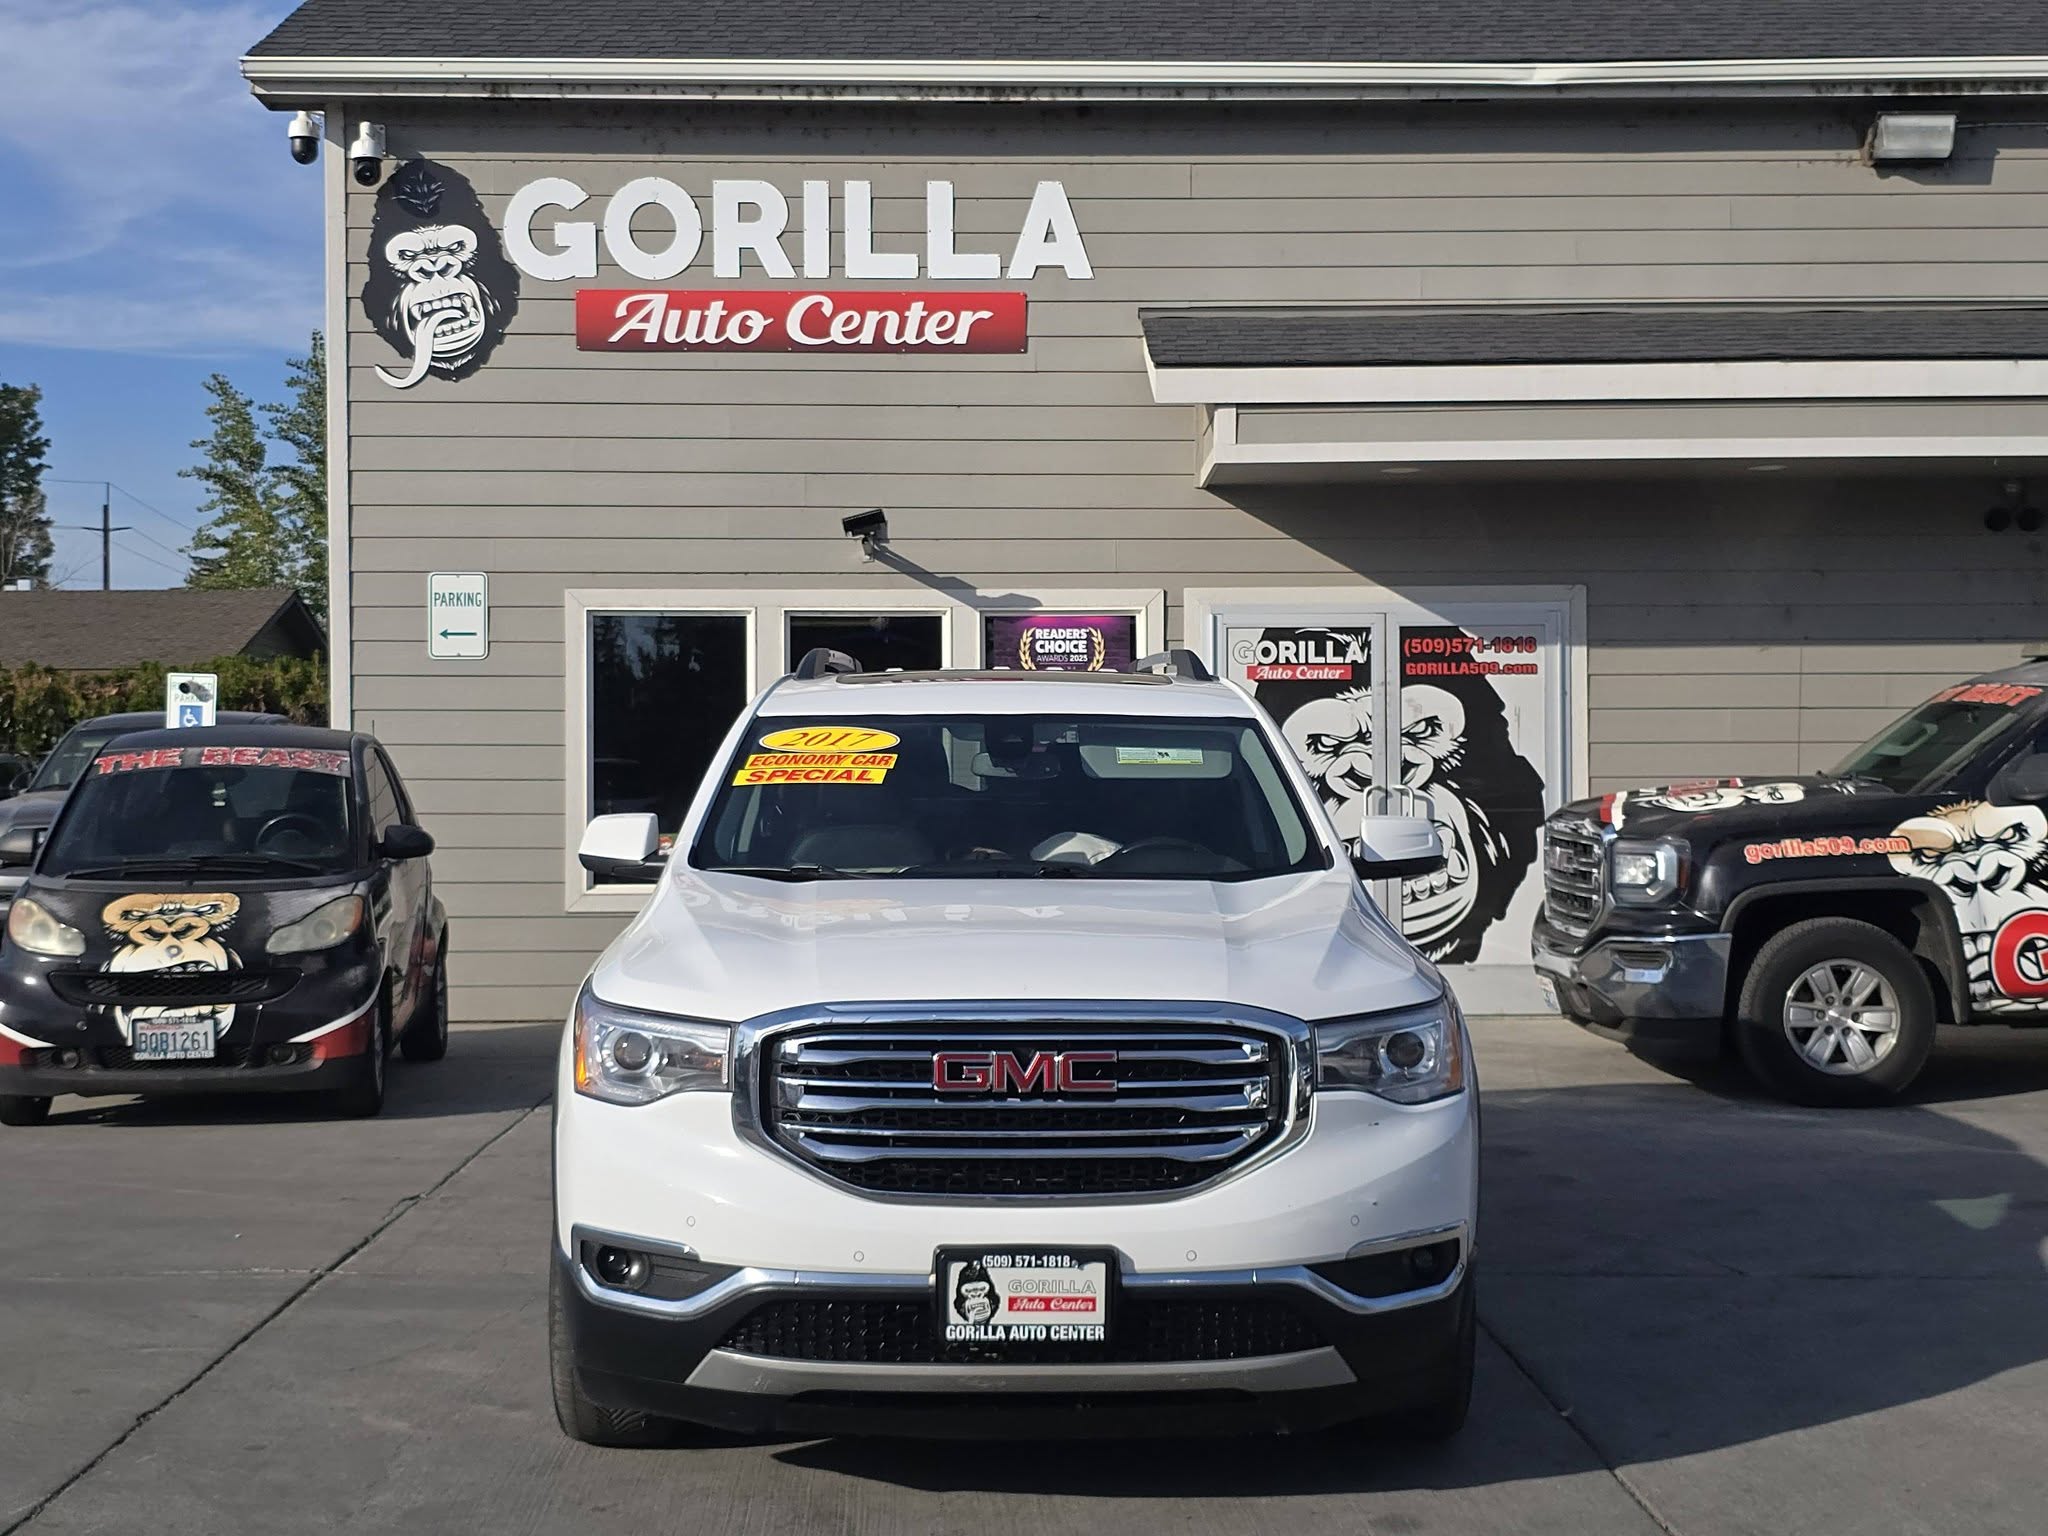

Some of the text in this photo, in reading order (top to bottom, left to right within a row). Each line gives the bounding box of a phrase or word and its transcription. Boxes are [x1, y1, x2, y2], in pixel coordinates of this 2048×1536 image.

[503, 177, 1095, 281] GORILLA
[608, 293, 994, 346] Auto Center
[433, 592, 482, 608] PARKING
[1035, 628, 1090, 640] READERS'
[1035, 640, 1088, 654] CHOICE
[1233, 640, 1366, 665] GORILLA
[1403, 636, 1538, 657] (509)571-1818
[1036, 654, 1088, 662] AWARDS 2025
[1255, 665, 1344, 680] Auto Center
[1405, 661, 1538, 676] GORILLA509.com
[779, 732, 877, 747] 2017
[94, 747, 350, 774] THE BEAST
[750, 754, 894, 767] ECONOMY CAR
[745, 769, 874, 783] SPECIAL
[1744, 836, 1911, 865] gorilla509.com
[933, 1050, 1118, 1093] GMC
[982, 1254, 1071, 1268] (509) 571-1818
[1008, 1279, 1097, 1294] GORILLA
[1013, 1298, 1094, 1311] Auto Center
[945, 1325, 1105, 1342] GORILLA AUTO CENTER
